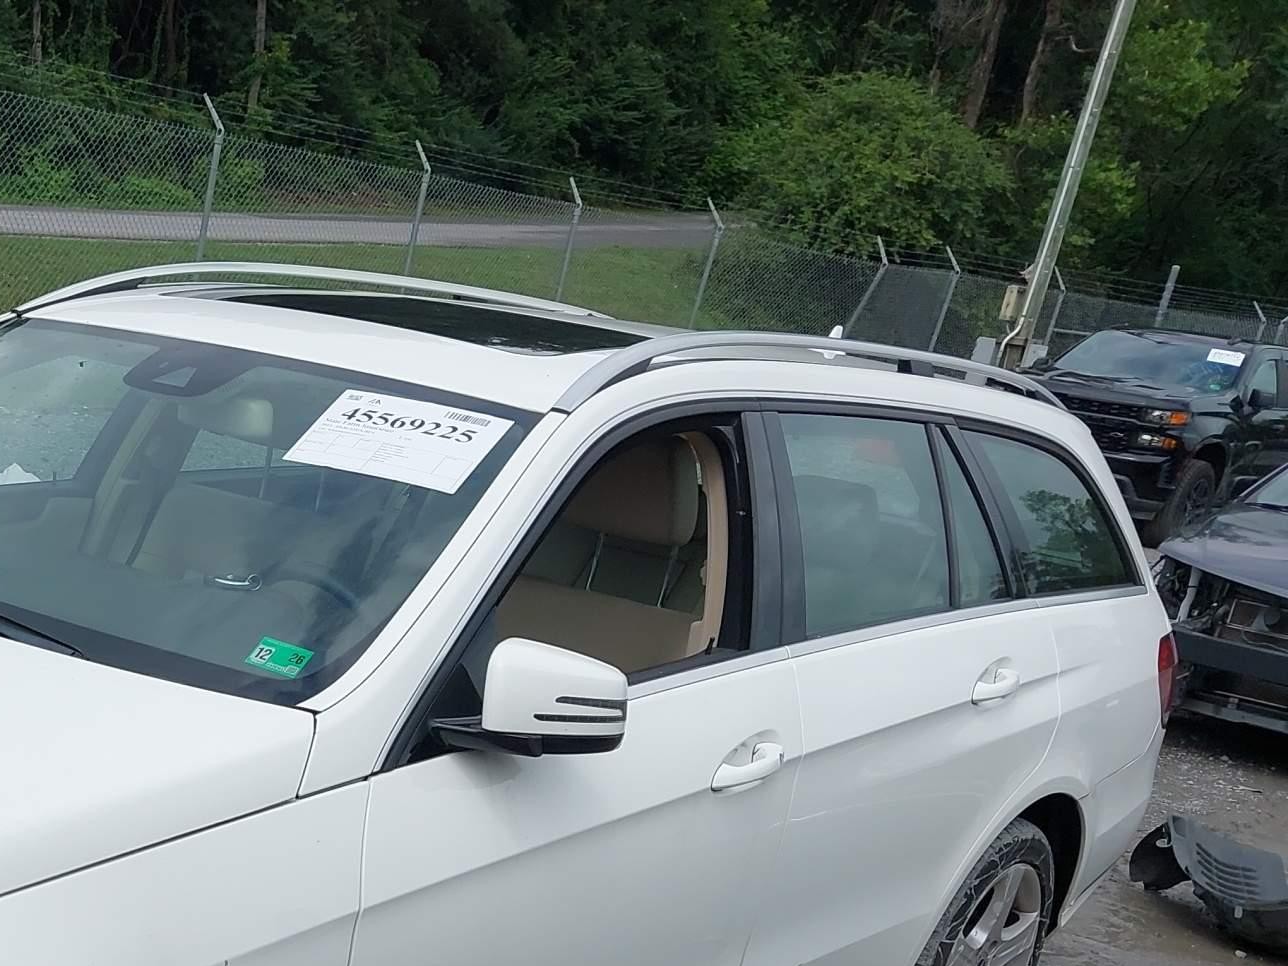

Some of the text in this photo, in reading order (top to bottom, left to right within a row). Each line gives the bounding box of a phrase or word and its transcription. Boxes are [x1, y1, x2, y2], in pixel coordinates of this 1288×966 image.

[341, 407, 479, 444] 45569225
[254, 646, 306, 665] 12 26
